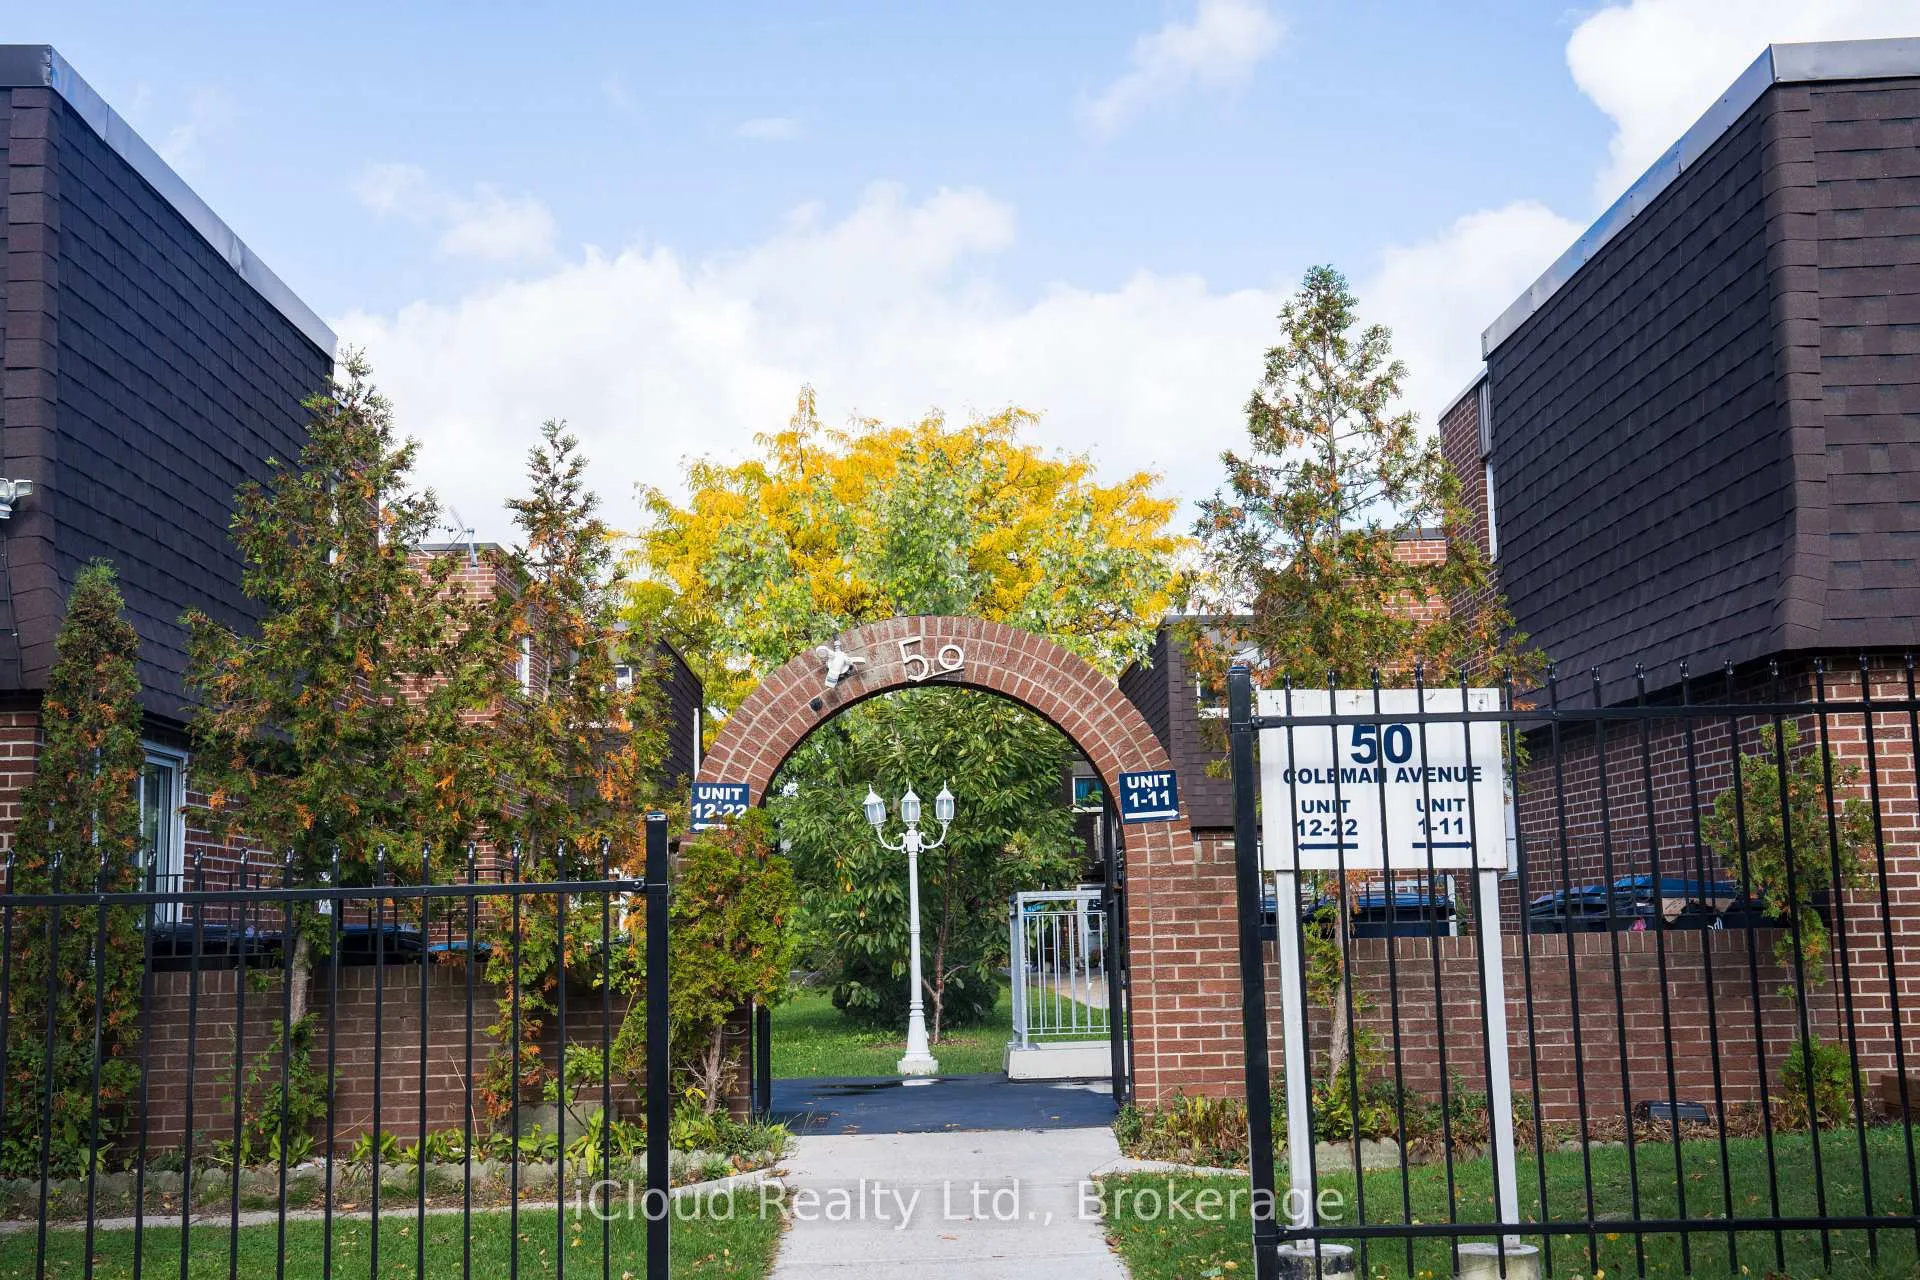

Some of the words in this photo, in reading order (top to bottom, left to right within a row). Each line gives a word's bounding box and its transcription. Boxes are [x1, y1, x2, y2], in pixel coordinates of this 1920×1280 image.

[898, 635, 965, 682] 50
[1350, 719, 1413, 764] 50
[1126, 774, 1171, 789] UNIT
[1395, 766, 1482, 783] AVENUE
[698, 787, 743, 800] UNIT
[1129, 789, 1170, 808] 1-11
[1301, 799, 1351, 813] UNIT
[1416, 798, 1466, 812] UNIT
[1418, 816, 1463, 835] 1-11
